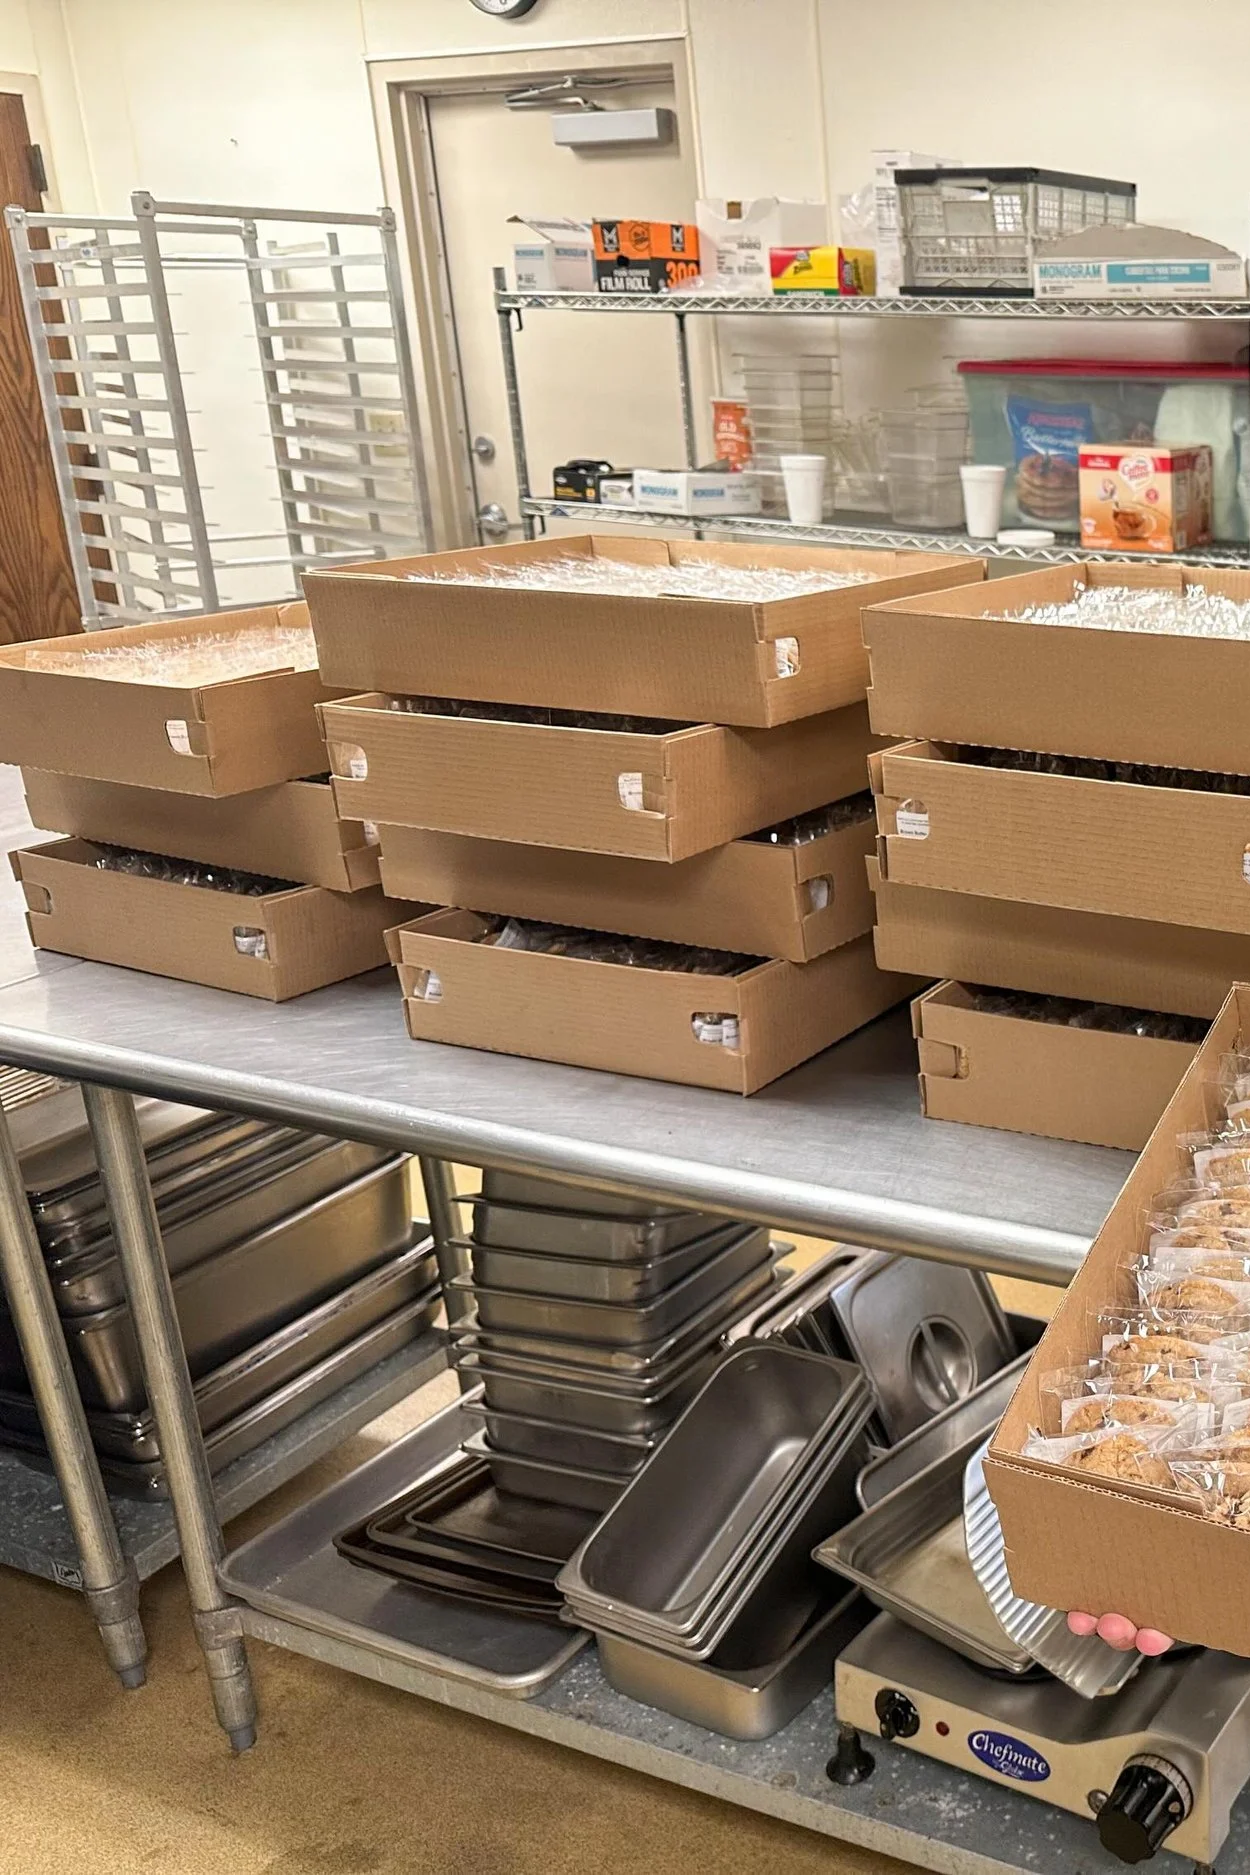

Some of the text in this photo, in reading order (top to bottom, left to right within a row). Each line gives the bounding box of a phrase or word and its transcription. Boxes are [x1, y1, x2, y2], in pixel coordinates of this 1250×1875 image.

[1039, 263, 1102, 279] MONOGRAM
[600, 276, 652, 292] FILM ROLL
[971, 1733, 1047, 1774] Chefmate
